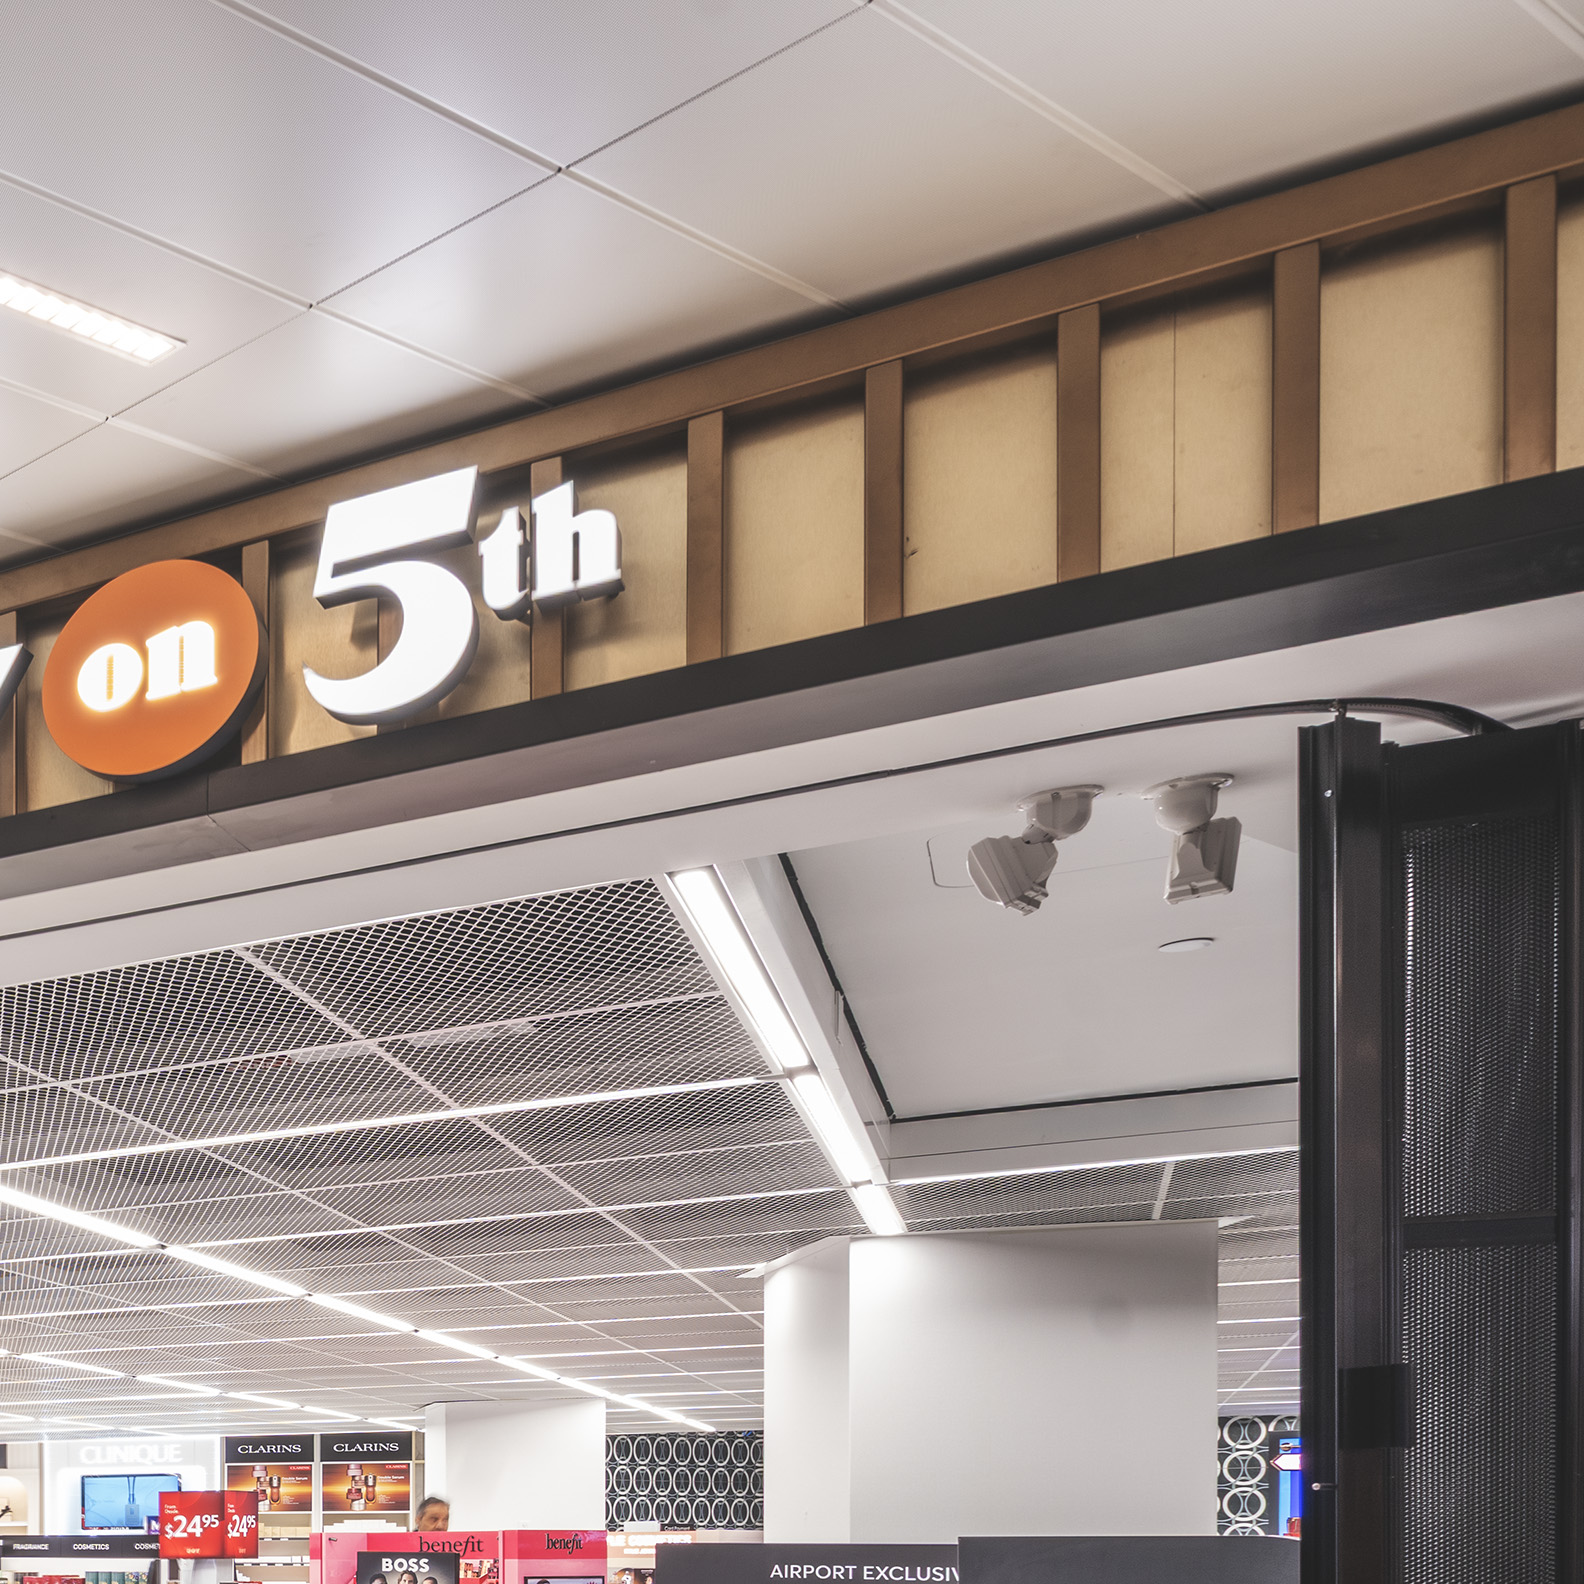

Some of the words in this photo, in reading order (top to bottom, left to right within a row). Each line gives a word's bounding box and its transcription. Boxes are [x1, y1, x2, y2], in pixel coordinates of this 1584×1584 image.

[77, 615, 218, 712] on
[302, 465, 625, 725] 5th
[81, 1444, 183, 1465] CLINIQUE
[238, 1444, 301, 1454] CLARINS
[333, 1443, 399, 1452] CLARINS
[419, 1536, 484, 1556] benefit
[545, 1533, 583, 1554] benefit
[382, 1558, 430, 1573] BOSS
[770, 1564, 857, 1580] AIRPORT
